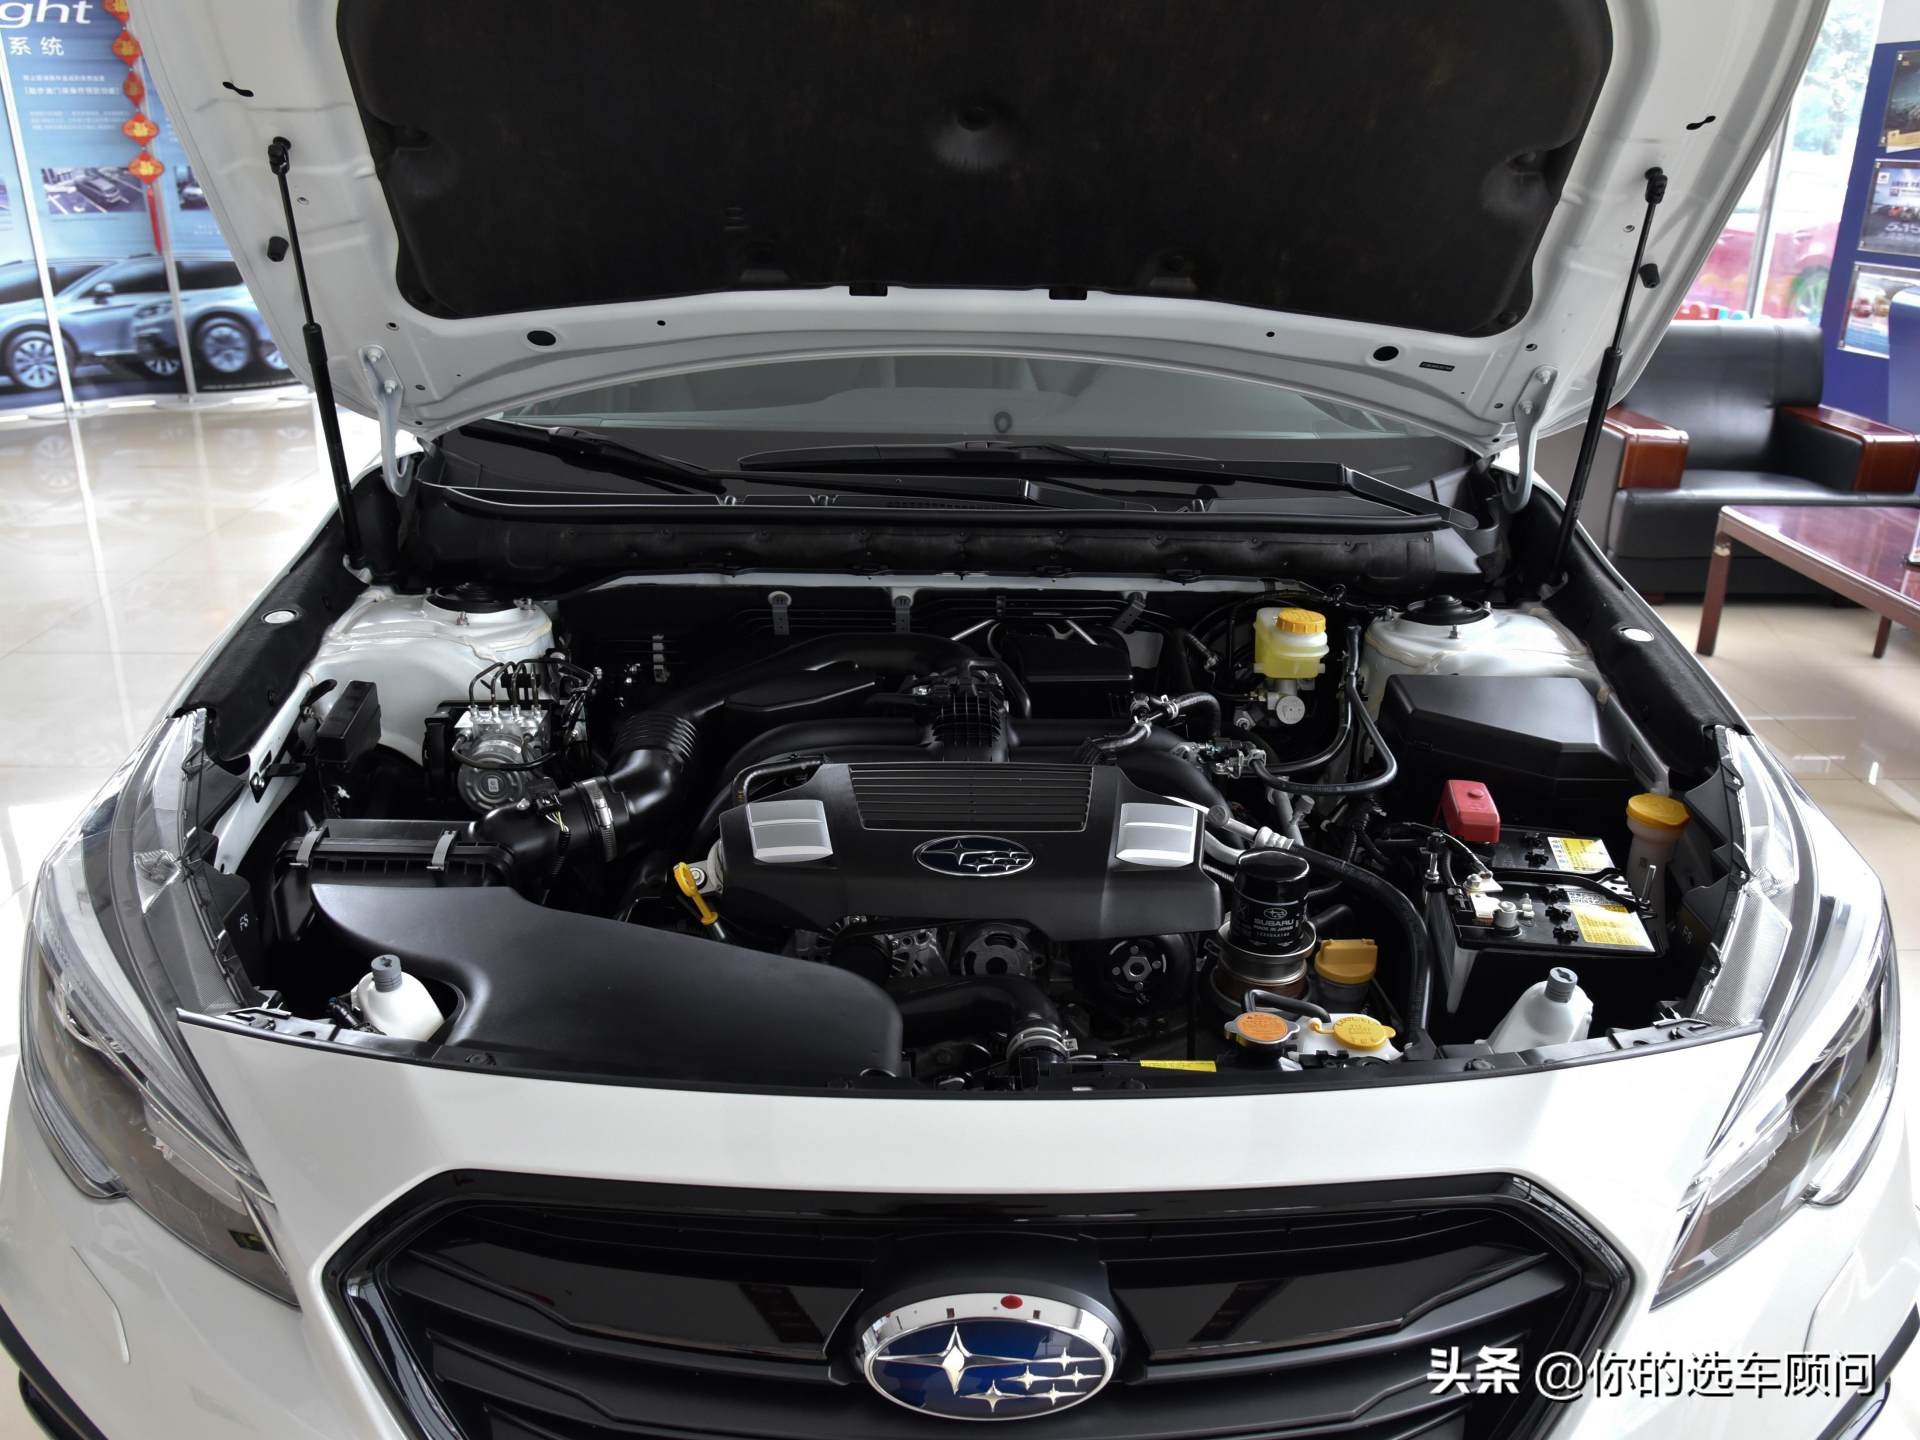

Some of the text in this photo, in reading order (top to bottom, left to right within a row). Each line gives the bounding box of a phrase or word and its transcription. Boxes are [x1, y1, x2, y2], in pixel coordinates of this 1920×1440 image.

[0, 0, 94, 29] ght
[9, 36, 65, 56] 系统
[1254, 918, 1294, 926] SUBARU
